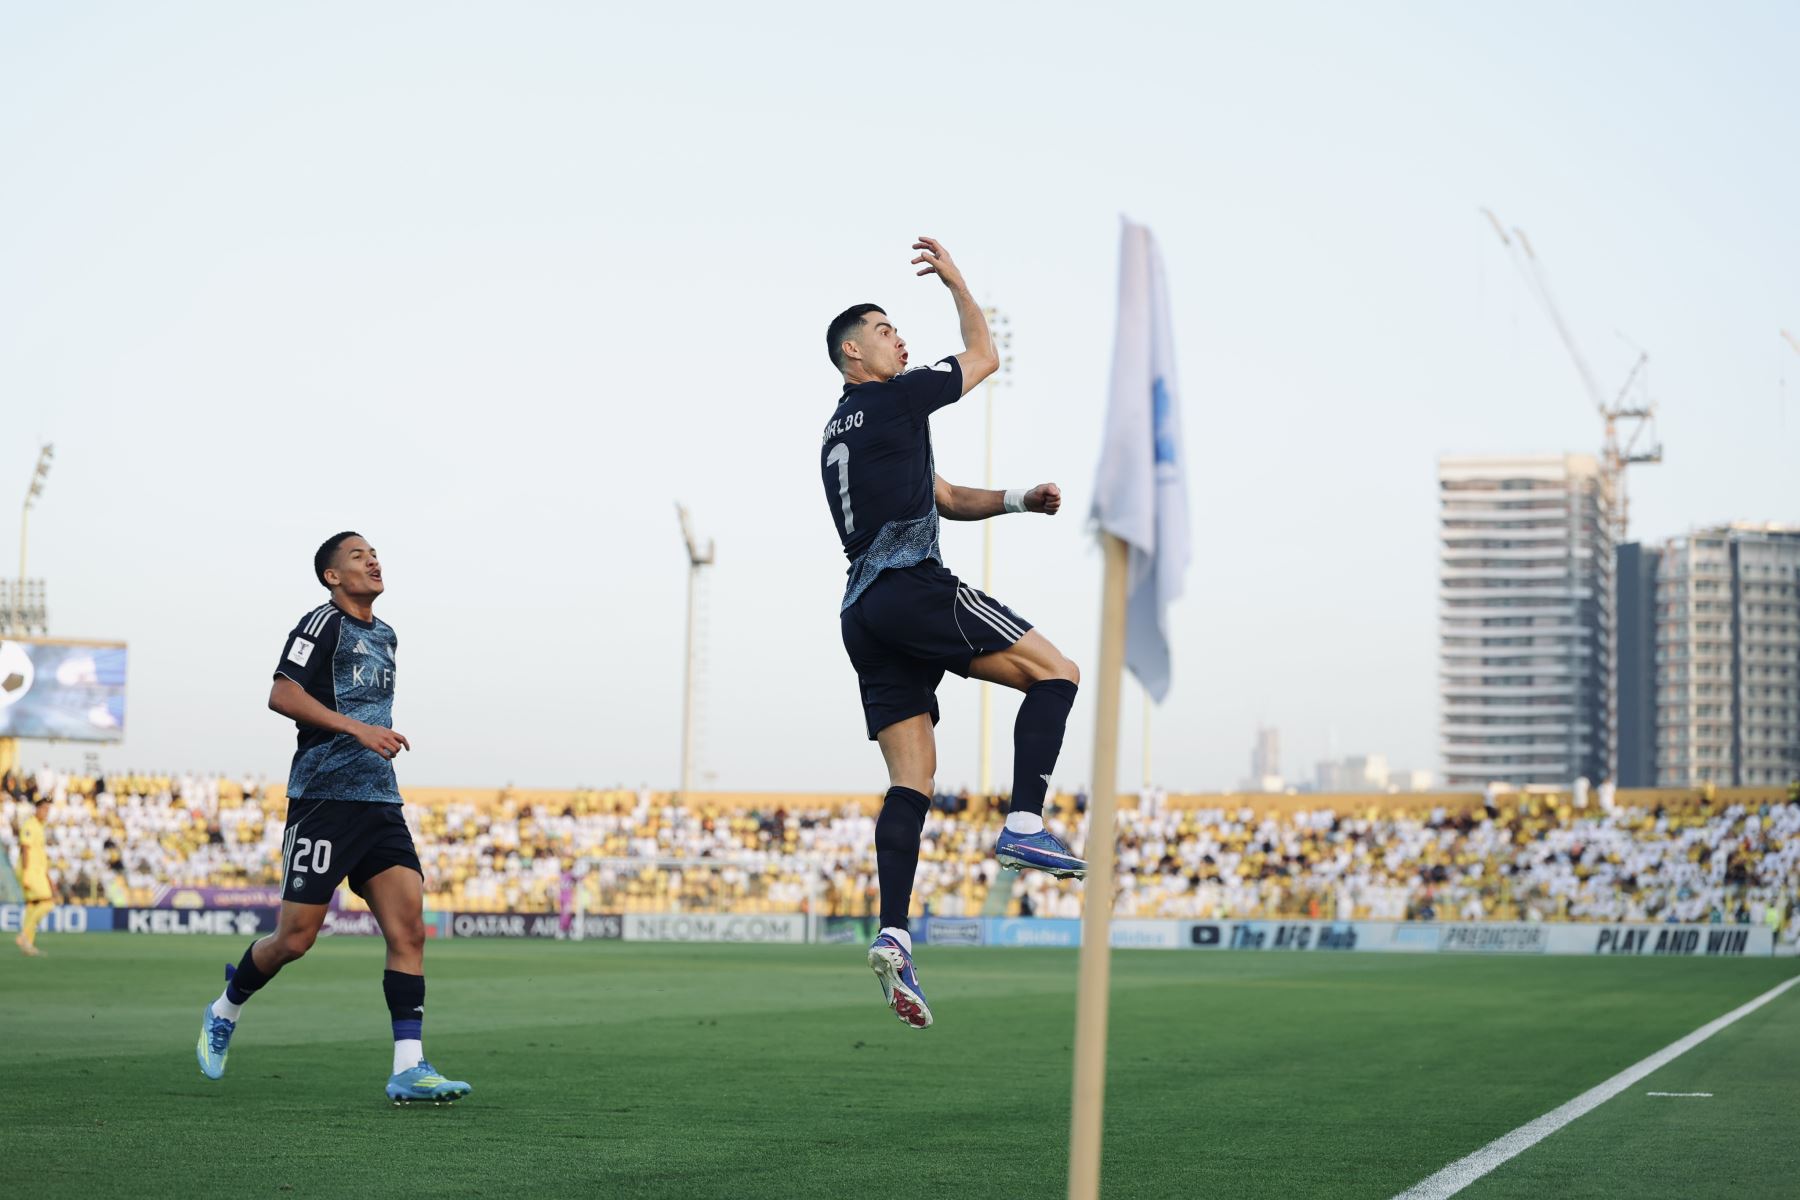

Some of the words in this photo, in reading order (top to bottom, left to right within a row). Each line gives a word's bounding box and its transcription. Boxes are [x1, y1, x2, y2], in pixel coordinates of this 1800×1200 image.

[292, 837, 332, 875] 20
[128, 909, 236, 935] KELME
[454, 914, 526, 938] QATAR
[636, 916, 792, 941] NEOM.COM
[1230, 924, 1266, 948] The
[1273, 925, 1313, 947] AFC
[1317, 925, 1358, 948] Hub
[1444, 926, 1542, 949] PREDICTOR
[1596, 929, 1650, 954] PLAY
[1655, 929, 1700, 954] AND
[1707, 930, 1749, 954] WIN
